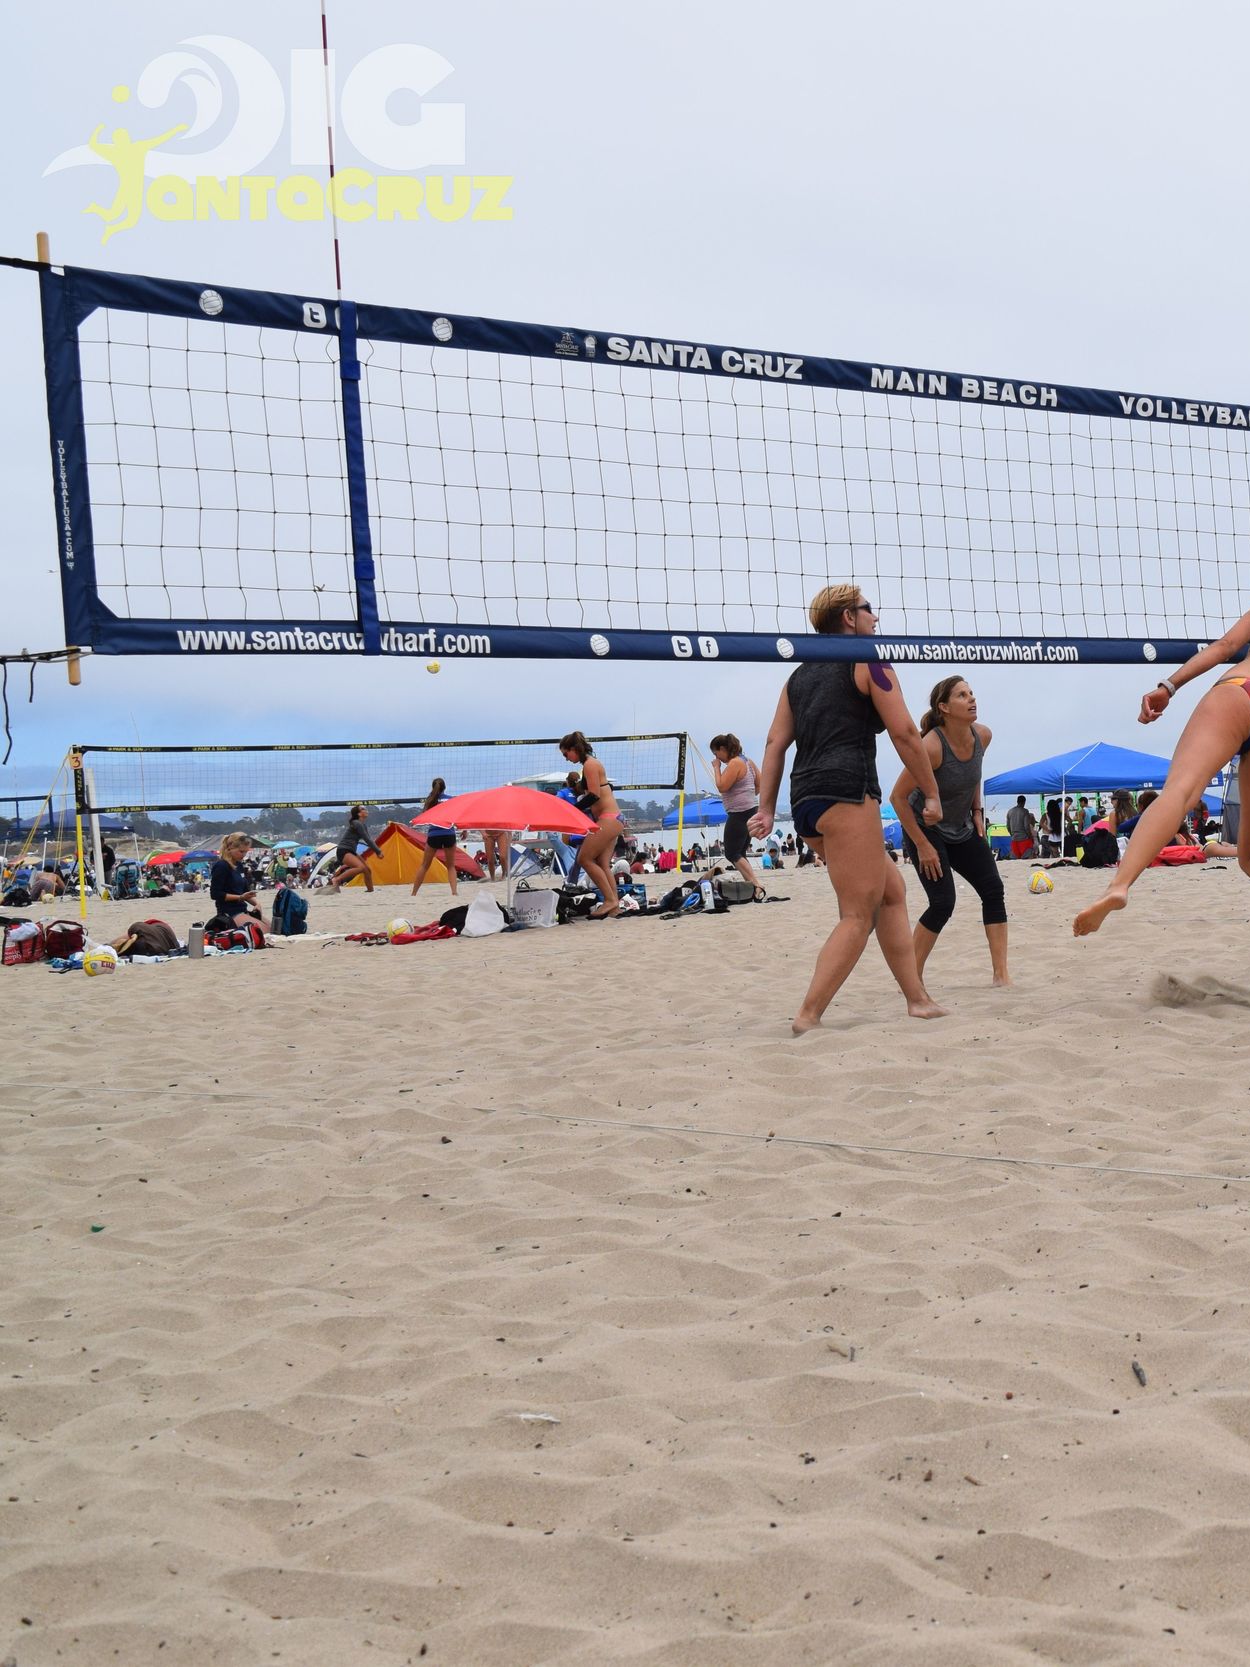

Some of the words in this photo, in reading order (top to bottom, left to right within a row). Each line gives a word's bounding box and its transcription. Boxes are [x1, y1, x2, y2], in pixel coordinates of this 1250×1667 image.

[606, 337, 712, 370] SANTA
[721, 351, 803, 380] CRUZ
[870, 368, 947, 395] MAIN
[961, 378, 1058, 407] BEACH
[875, 641, 1078, 661] www.santacruzwharf.com
[72, 756, 81, 768] 3
